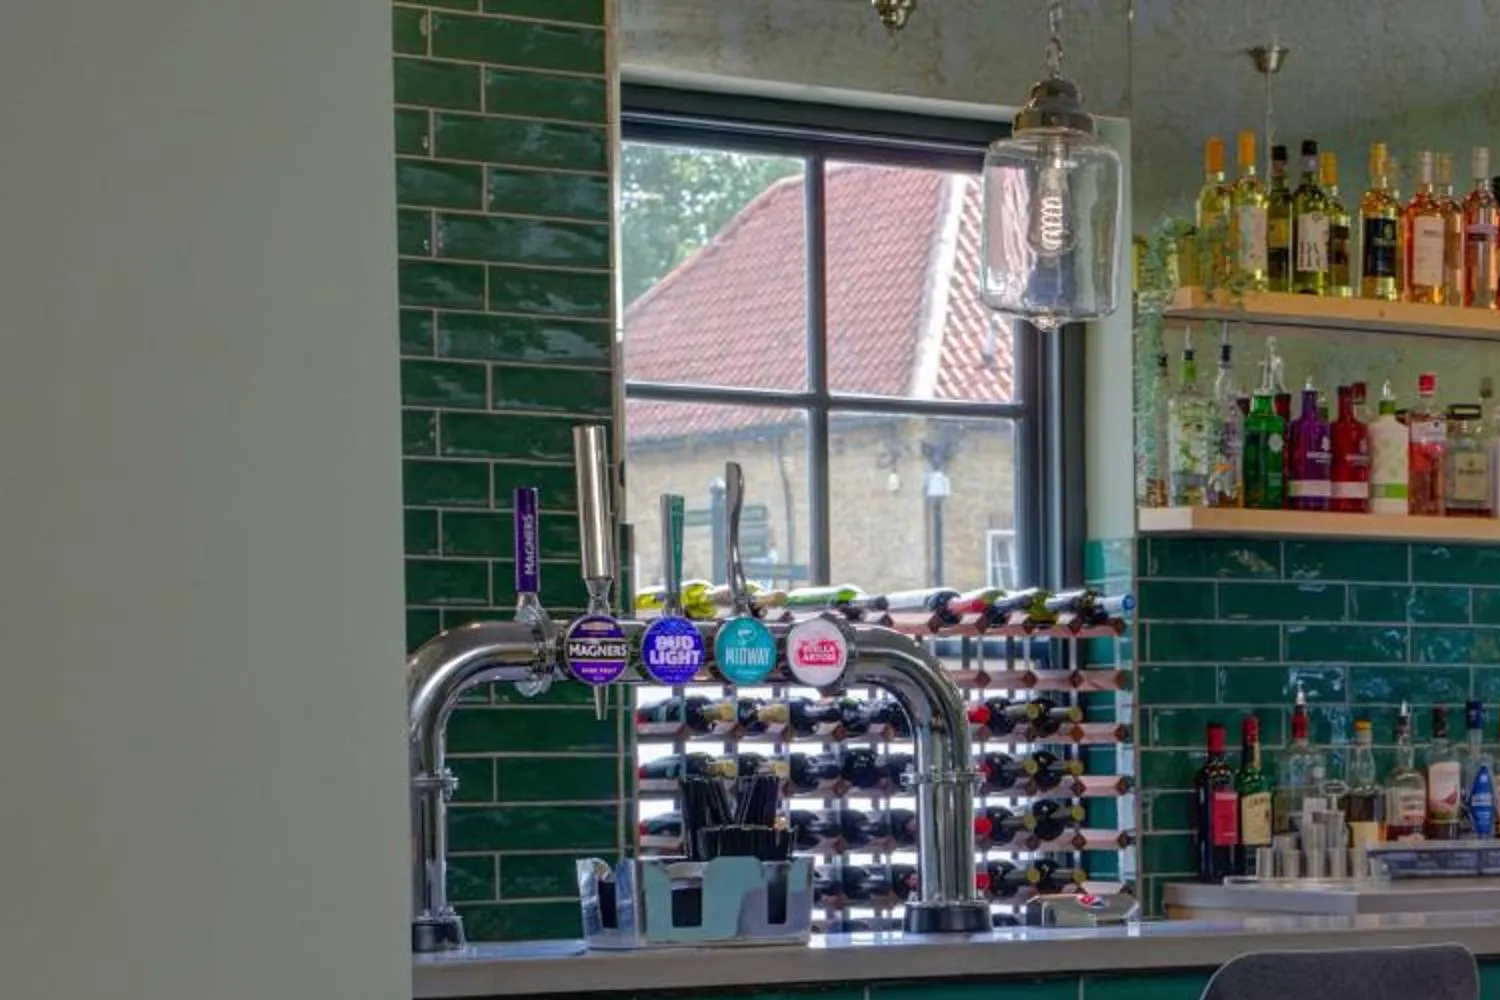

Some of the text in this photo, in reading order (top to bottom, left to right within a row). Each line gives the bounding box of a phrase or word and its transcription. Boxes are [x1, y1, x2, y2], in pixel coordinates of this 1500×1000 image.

[522, 513, 535, 575] MAGNERS
[569, 643, 627, 657] MAGNERS
[654, 635, 695, 650] BUD
[649, 649, 701, 665] LIGHT
[725, 647, 770, 665] MIDWAY
